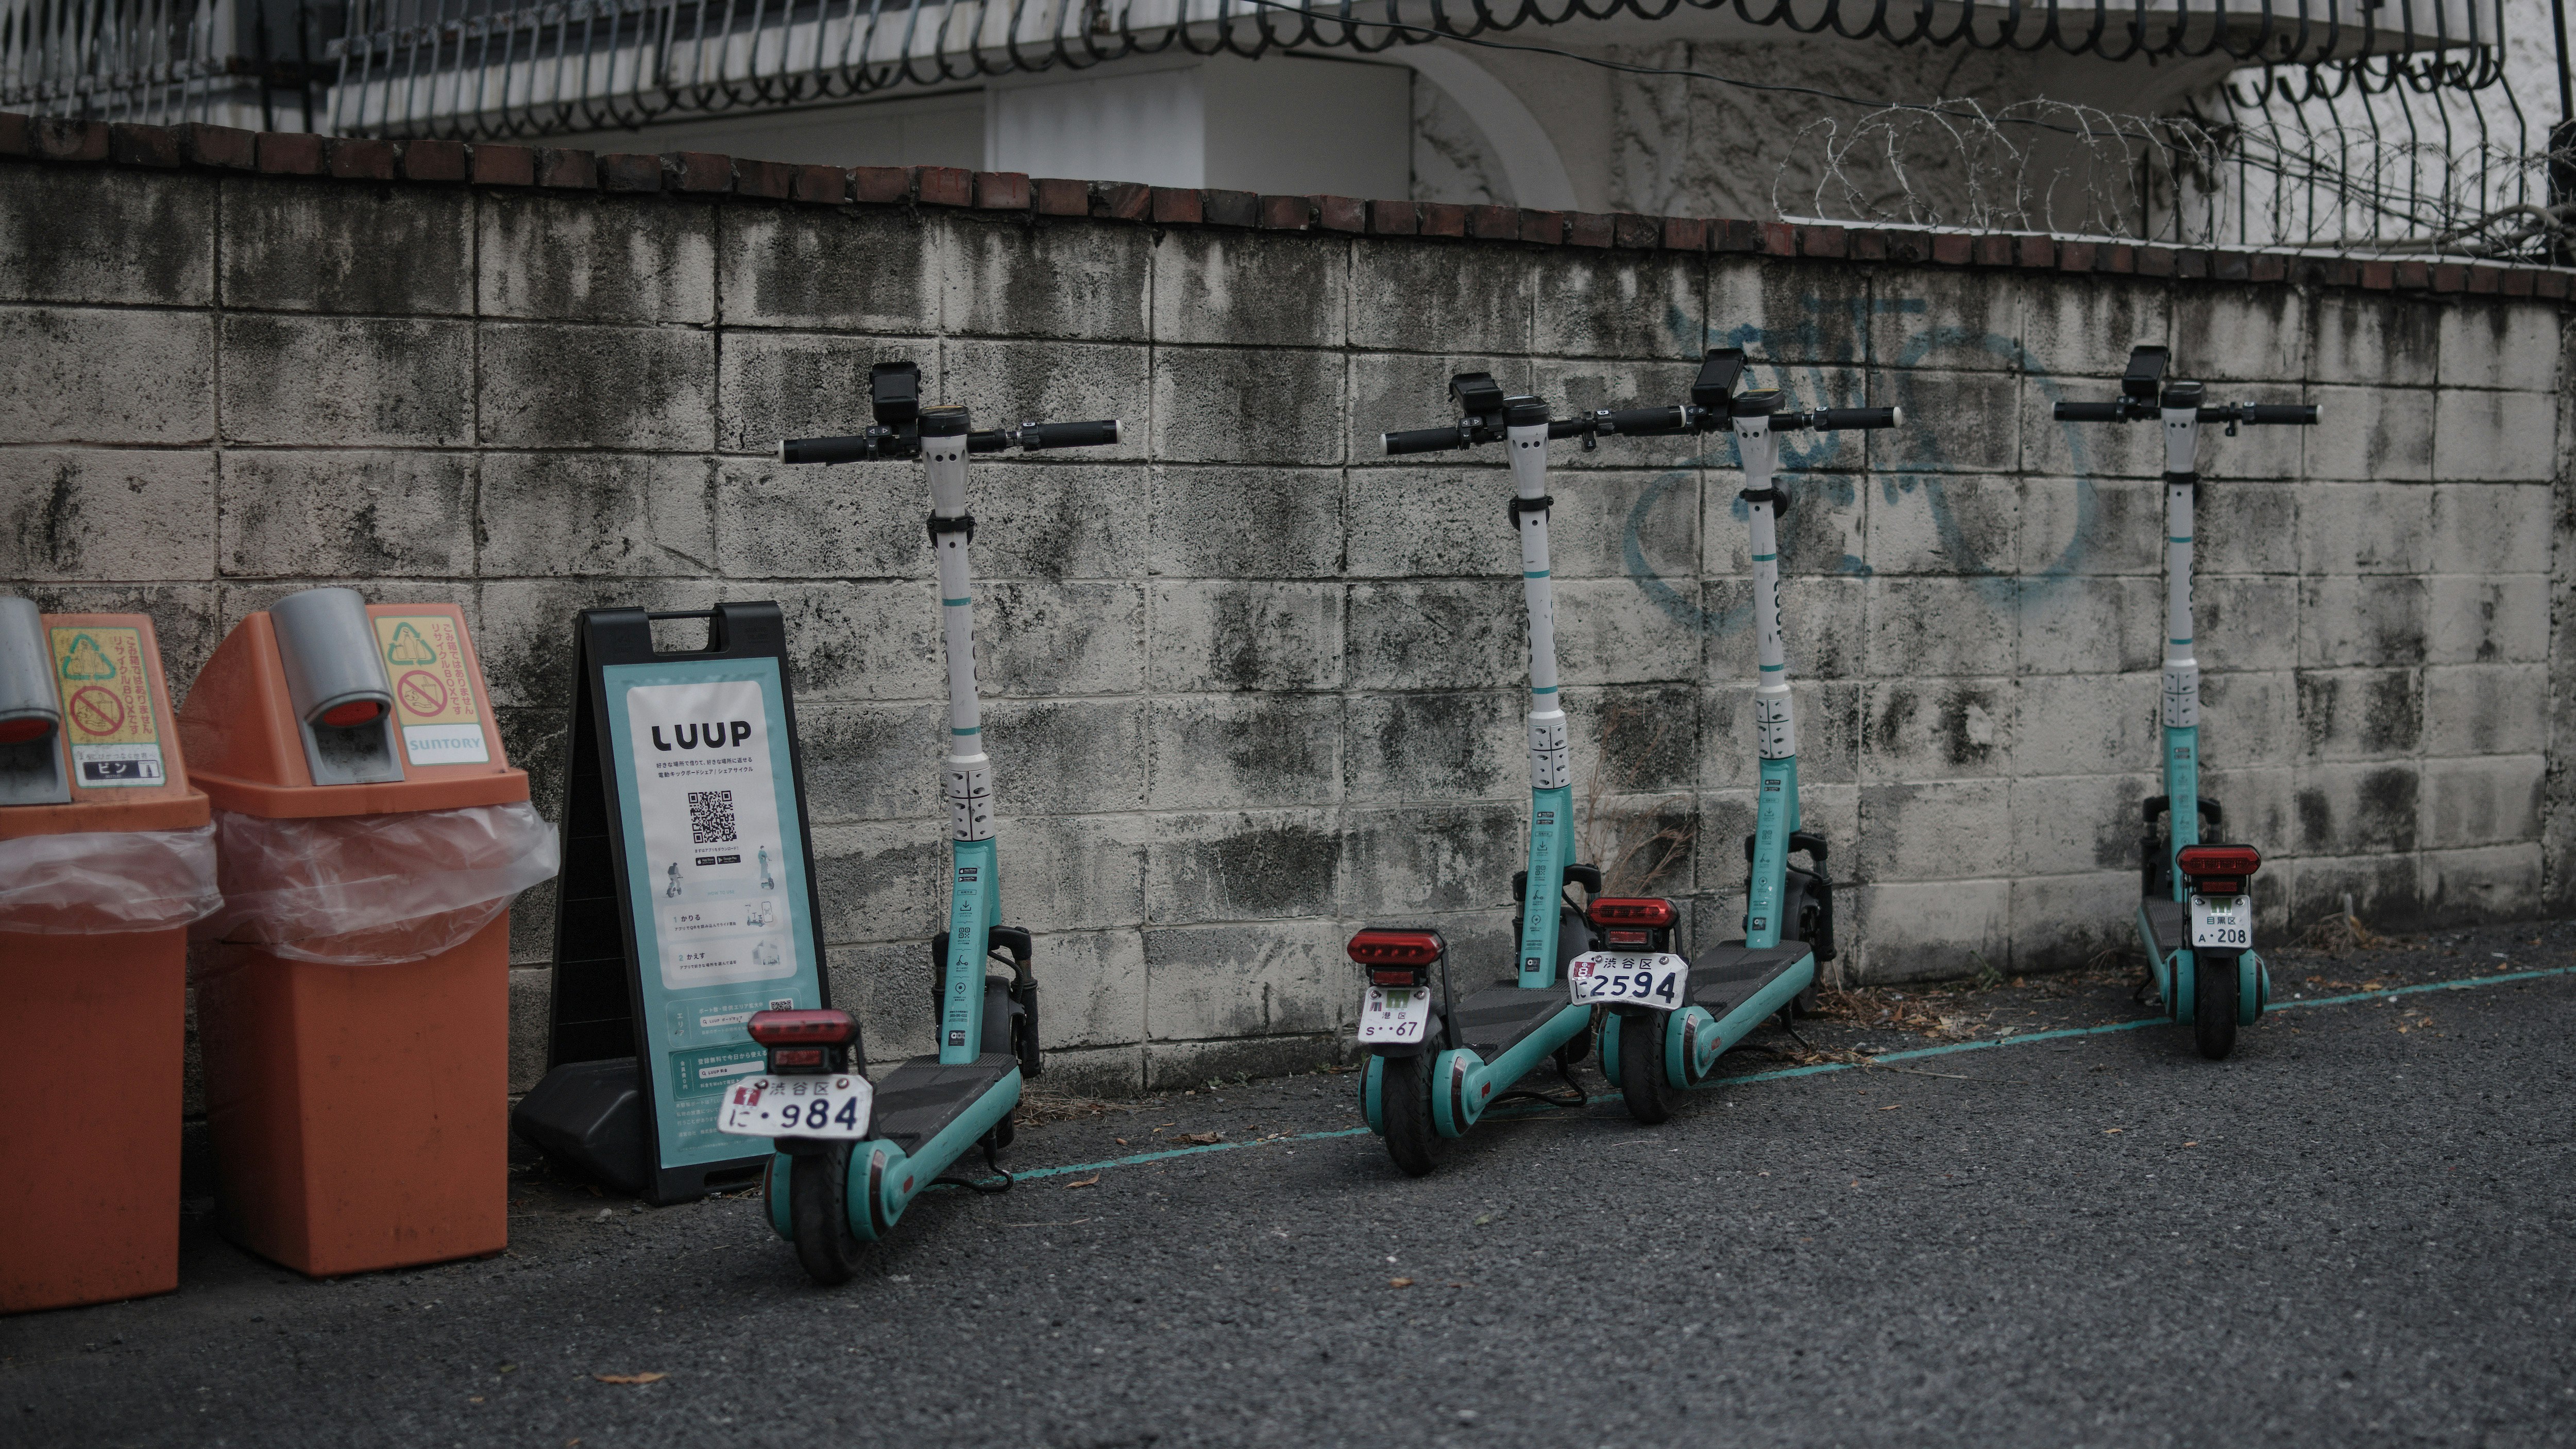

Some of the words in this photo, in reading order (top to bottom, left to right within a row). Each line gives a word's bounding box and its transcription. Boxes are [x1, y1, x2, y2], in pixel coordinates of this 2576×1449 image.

[651, 721, 752, 751] LUUP
[410, 738, 481, 751] SUNTORY
[98, 762, 127, 774] ビン
[681, 914, 701, 922] かりる
[2207, 916, 2236, 925] 目黒区
[686, 952, 705, 960] かえす
[1603, 957, 1653, 970] 渋谷区
[769, 1081, 830, 1096] 渋谷区
